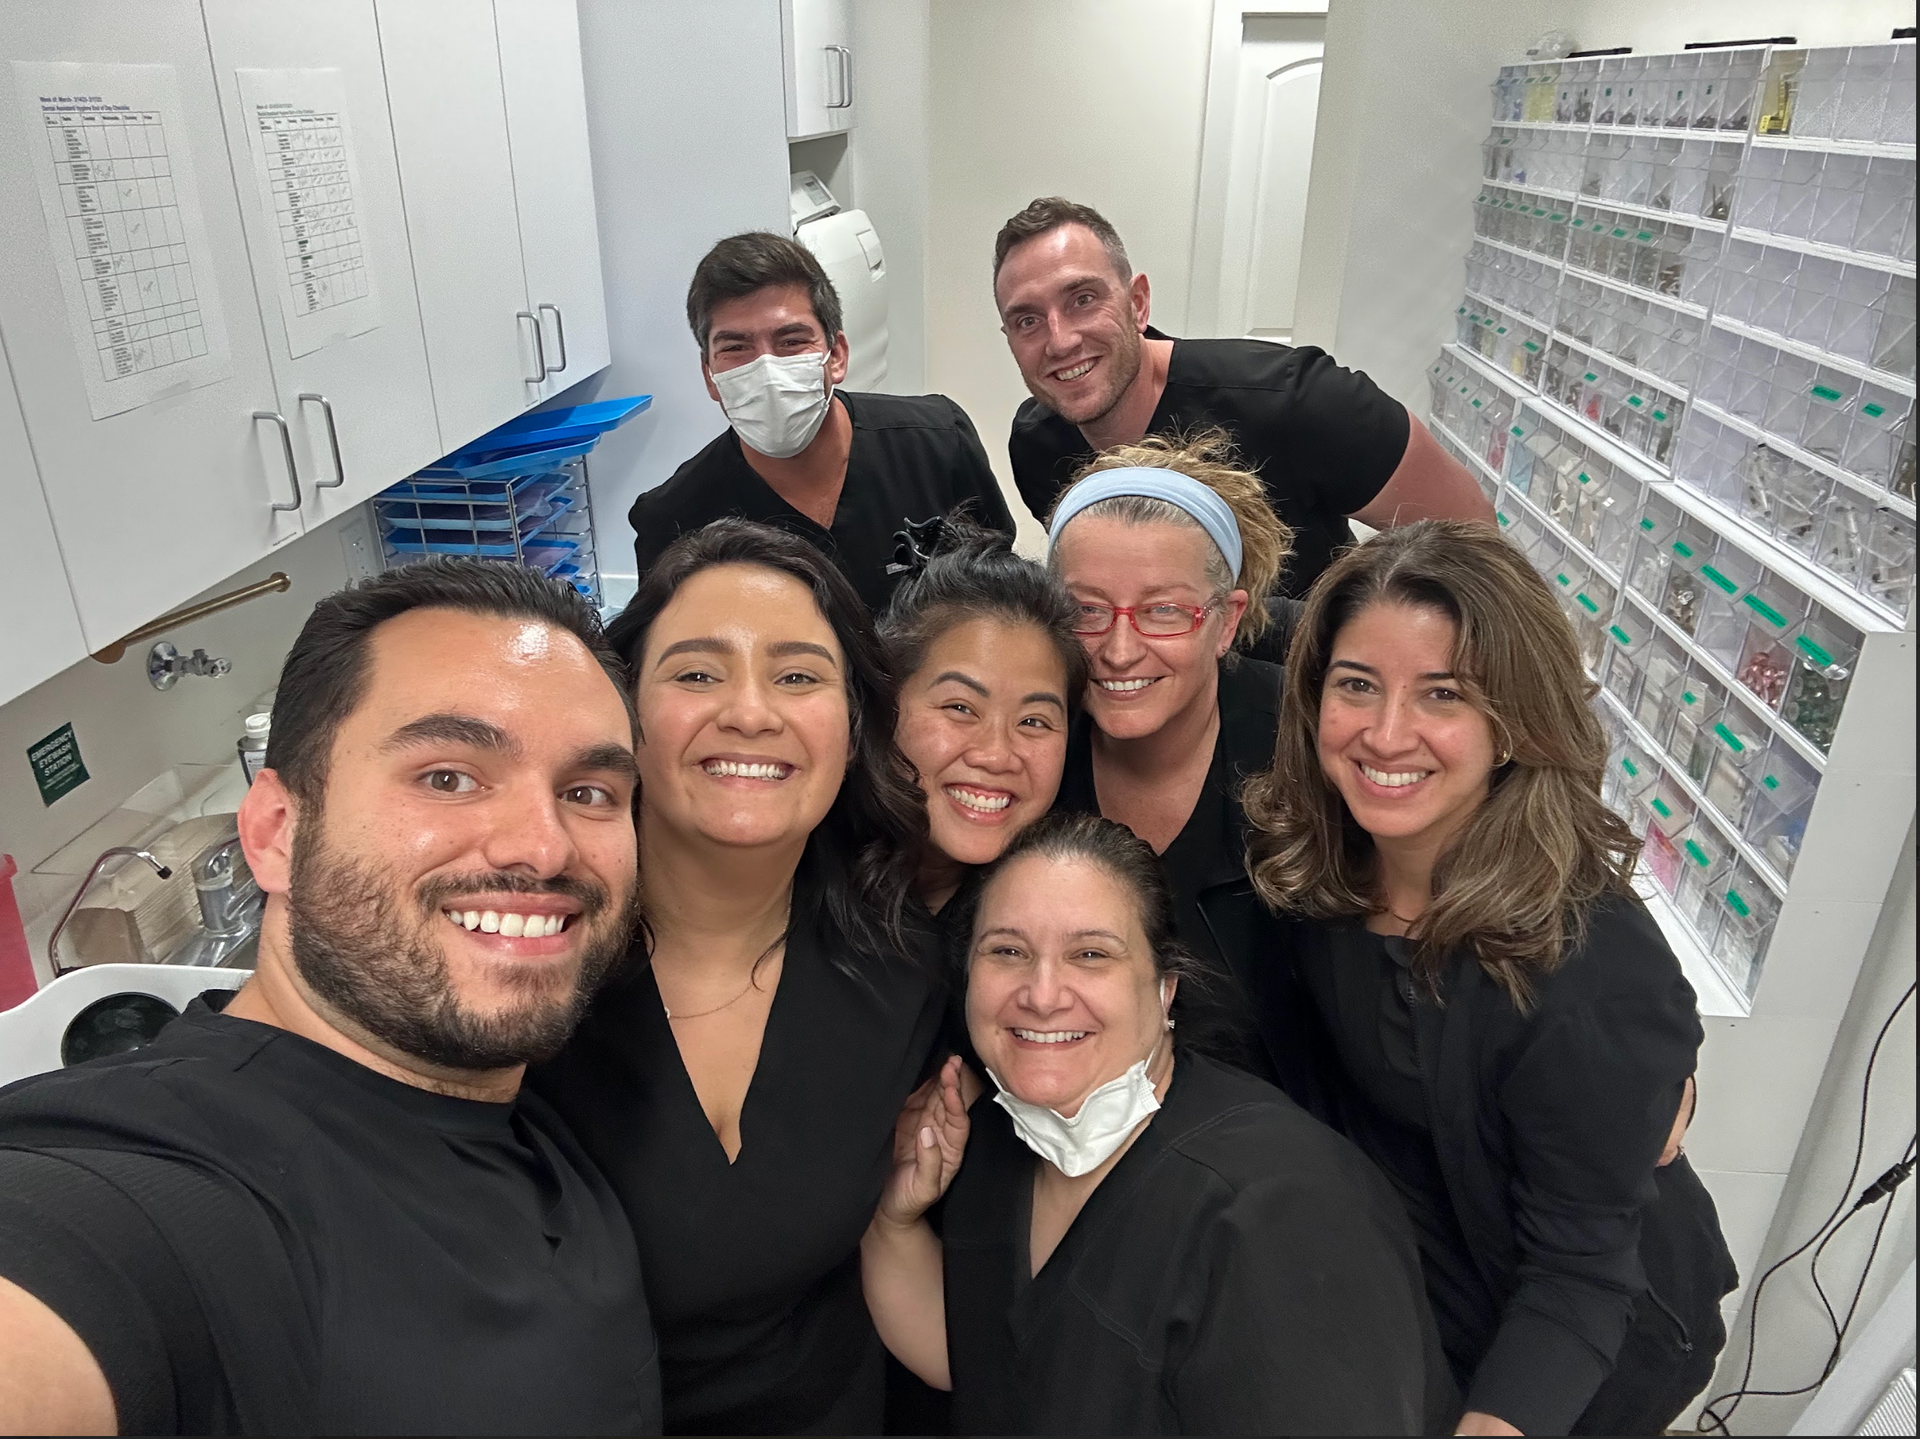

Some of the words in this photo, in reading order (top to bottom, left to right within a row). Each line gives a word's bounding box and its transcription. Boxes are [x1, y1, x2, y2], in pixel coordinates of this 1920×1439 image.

[31, 730, 72, 761] EMERGENCY
[39, 742, 72, 768] EYEWASH
[44, 753, 73, 776] STATION
